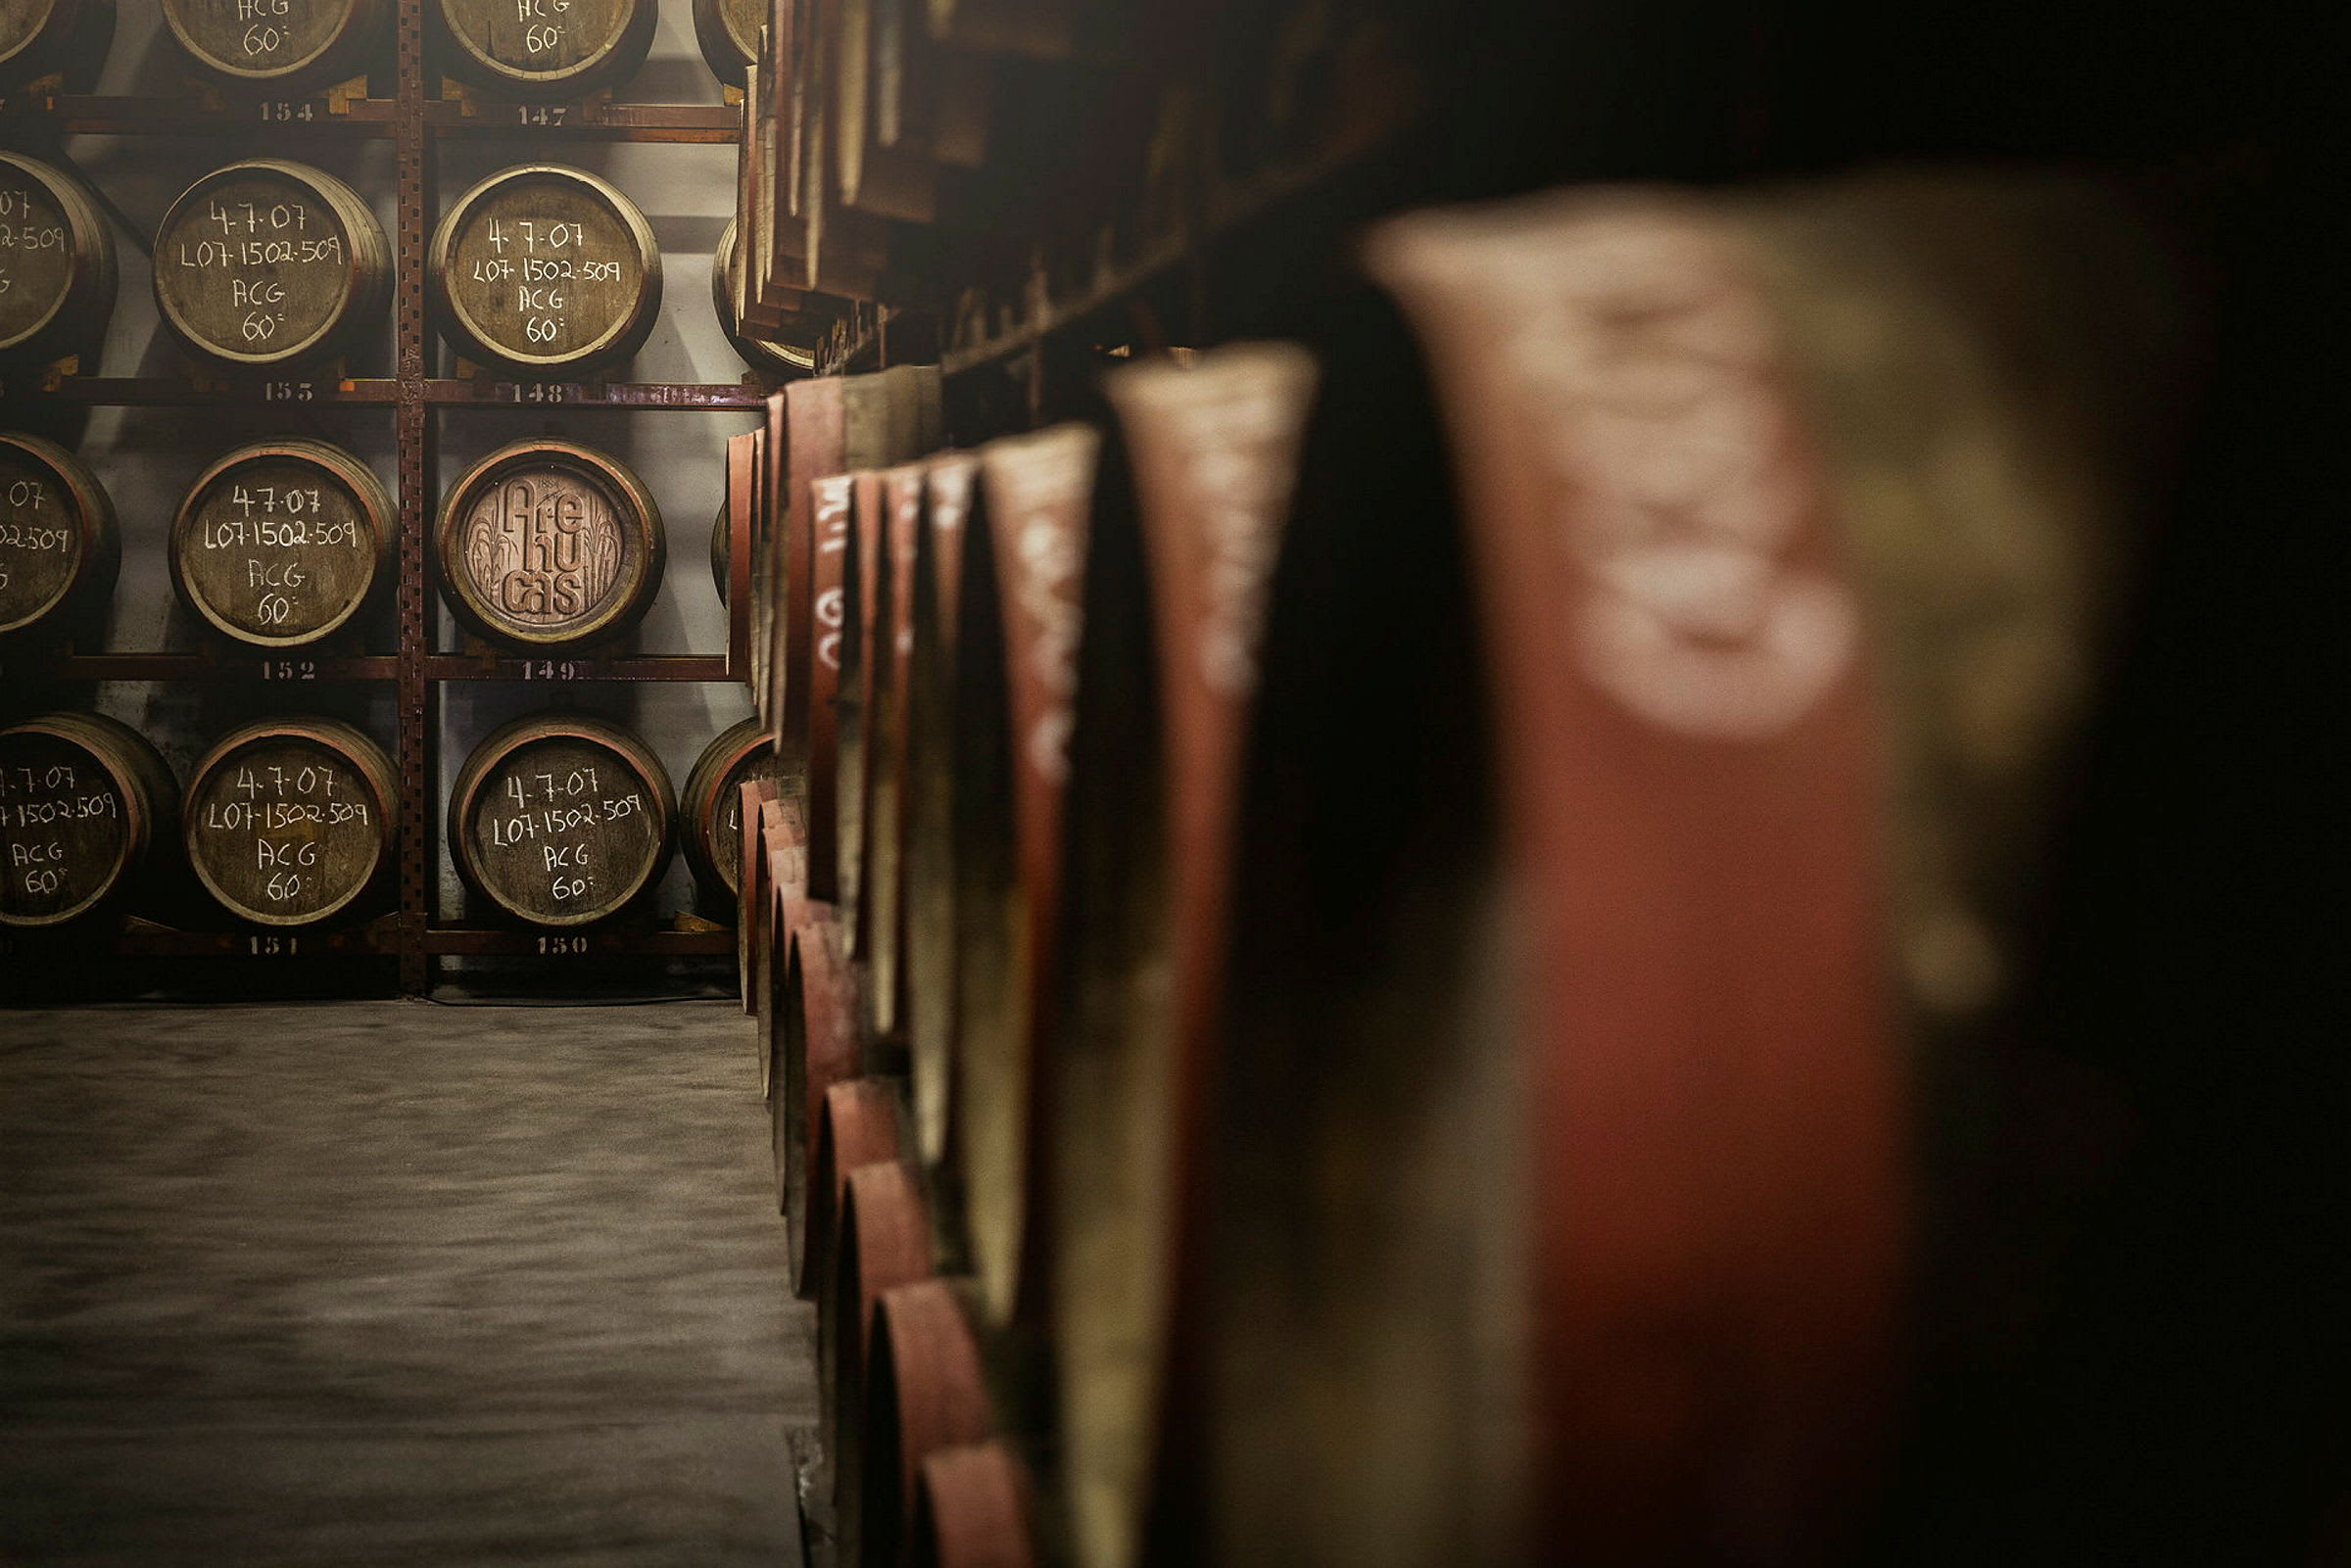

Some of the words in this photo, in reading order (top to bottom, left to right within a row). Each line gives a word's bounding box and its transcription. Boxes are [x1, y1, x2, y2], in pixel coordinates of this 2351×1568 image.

[259, 102, 313, 122] 154
[518, 106, 567, 125] 147
[233, 278, 285, 307] ACG
[518, 286, 563, 311] ACG
[265, 382, 313, 402] 155
[512, 383, 562, 404] 148
[249, 558, 305, 588] ACG
[264, 661, 314, 681] 152
[522, 660, 575, 680] 149
[12, 841, 63, 867] ACG
[258, 838, 315, 869] ACG
[544, 843, 588, 871] ACG
[250, 935, 297, 955] 151
[538, 936, 588, 954] 150
